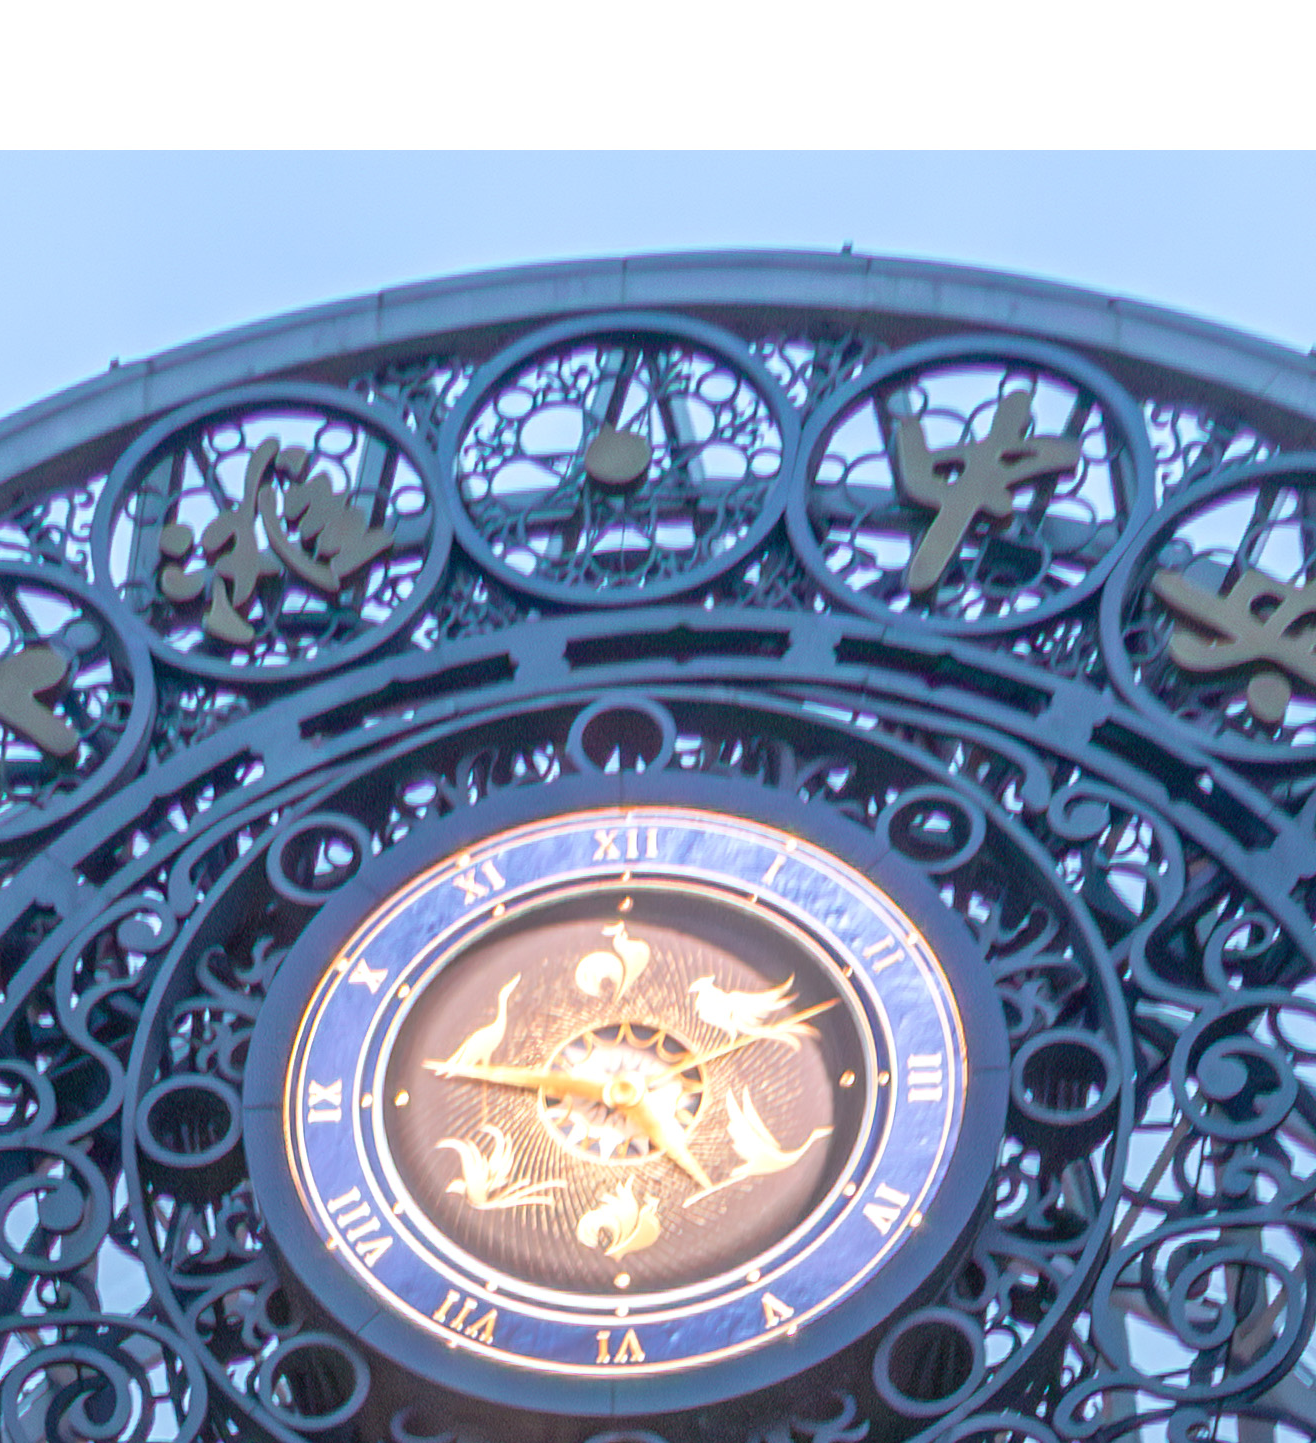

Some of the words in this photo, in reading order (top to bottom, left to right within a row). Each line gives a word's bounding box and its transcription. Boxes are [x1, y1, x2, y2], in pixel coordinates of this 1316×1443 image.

[593, 828, 659, 860] XII
[453, 860, 506, 904] XI
[864, 934, 905, 971] II
[348, 959, 388, 994] X
[907, 1054, 942, 1102] III
[308, 1079, 342, 1123] IX
[327, 1186, 393, 1268] VIII
[861, 1182, 909, 1234] IV
[434, 1289, 497, 1343] VII
[762, 1294, 794, 1327] V
[596, 1330, 645, 1363] VI
